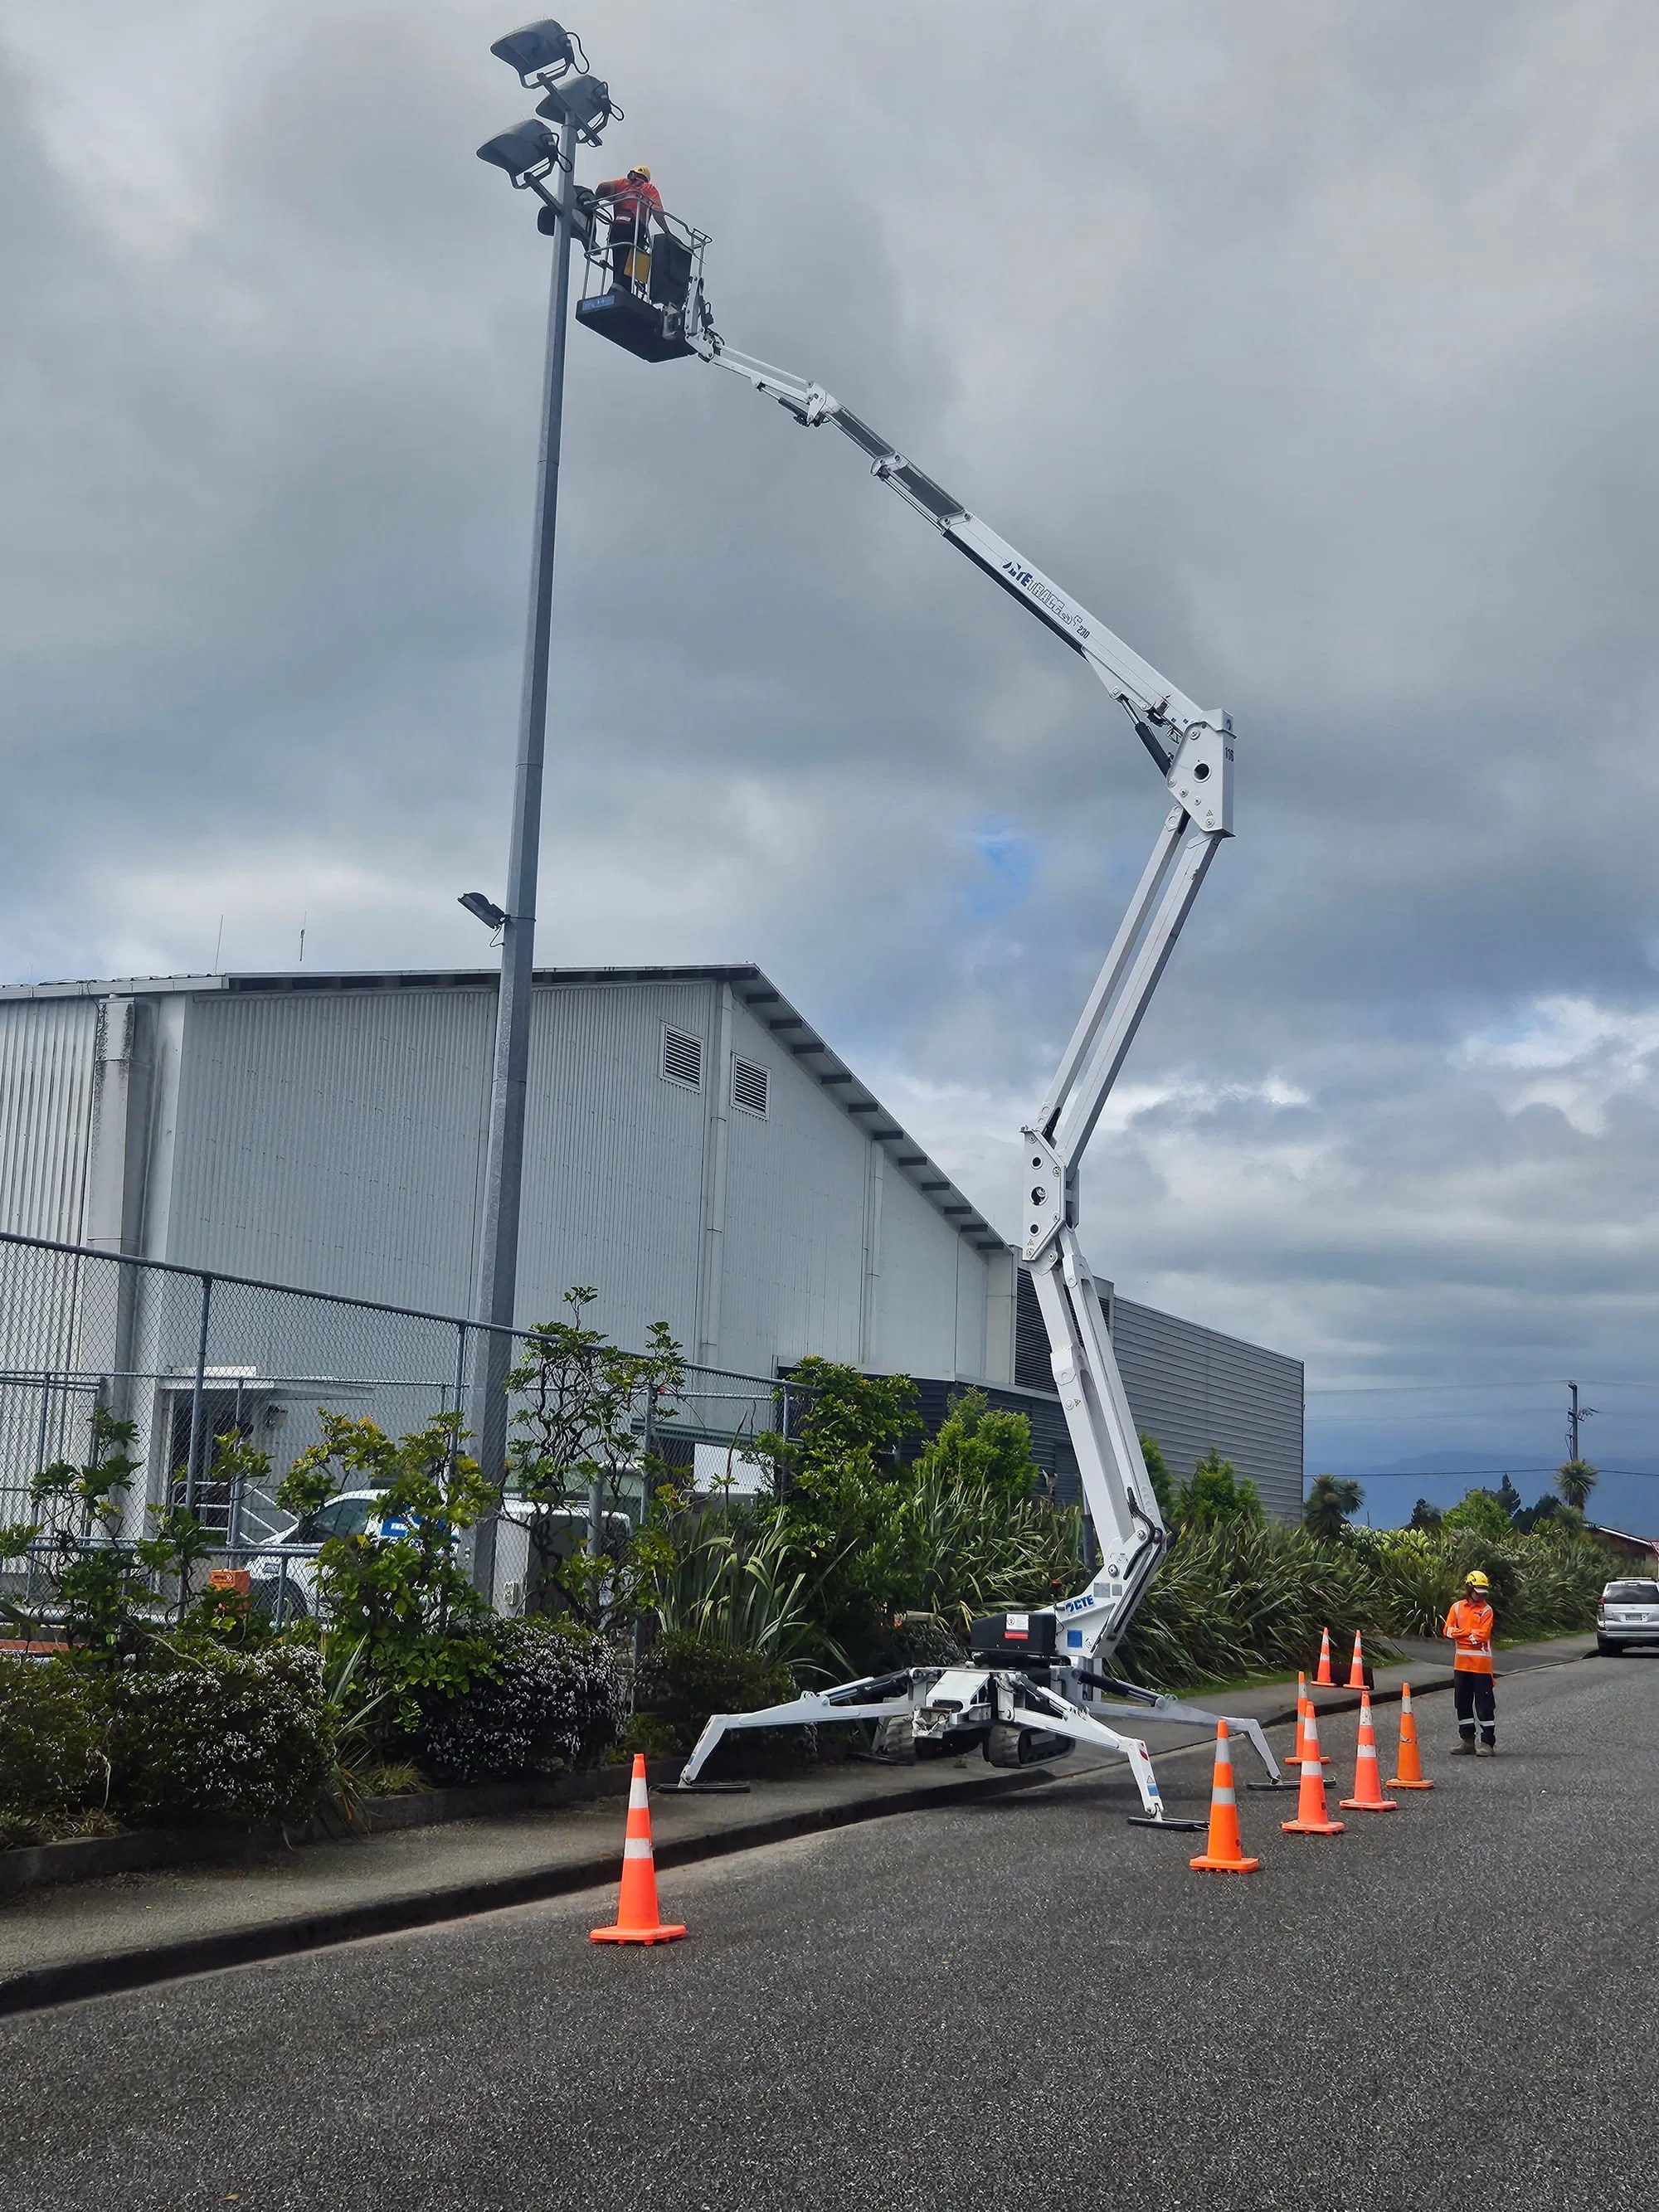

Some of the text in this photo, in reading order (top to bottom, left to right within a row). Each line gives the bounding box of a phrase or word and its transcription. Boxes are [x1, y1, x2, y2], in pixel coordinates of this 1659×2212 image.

[1007, 562, 1034, 587] CTE
[1076, 625, 1091, 639] 230
[1073, 1594, 1094, 1611] CTE
